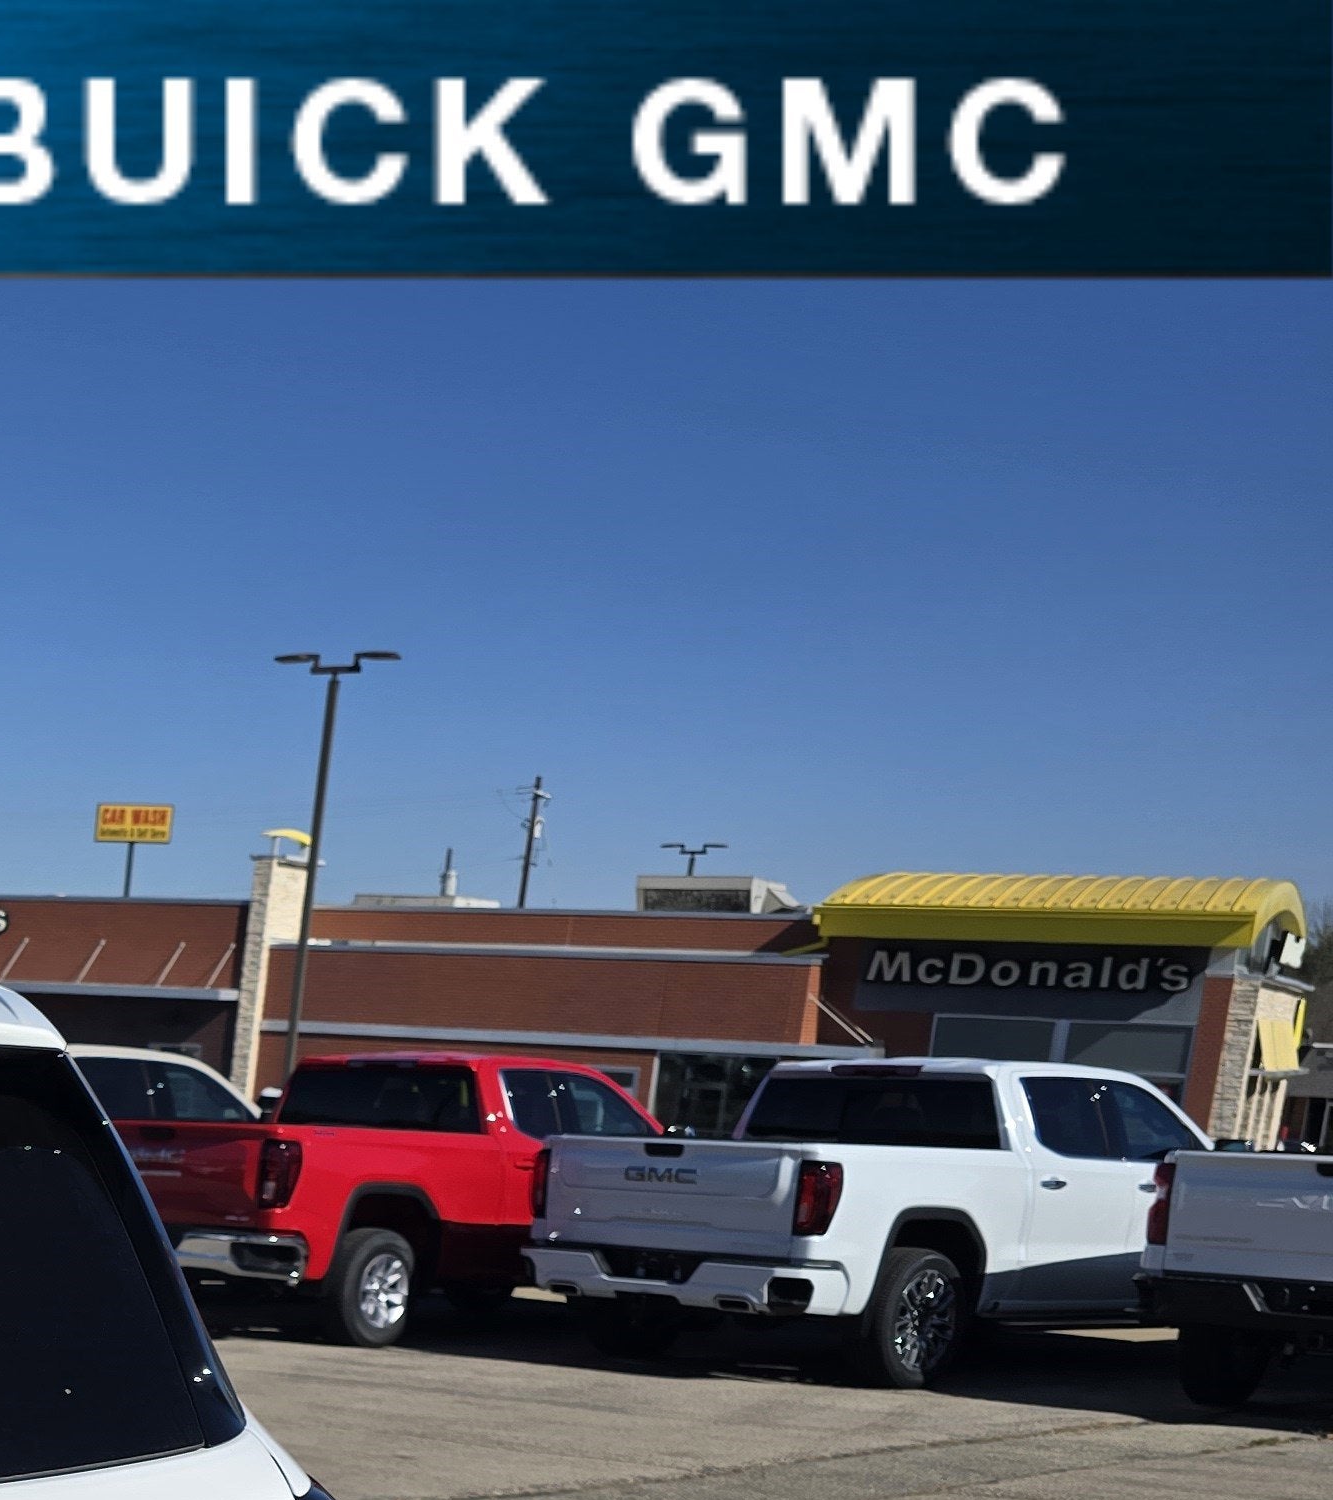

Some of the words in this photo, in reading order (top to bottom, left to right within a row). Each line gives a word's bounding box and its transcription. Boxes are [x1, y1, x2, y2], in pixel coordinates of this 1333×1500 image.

[101, 808, 126, 826] CAR
[131, 809, 170, 827] WASH
[865, 949, 1190, 992] McDonald's
[623, 1165, 698, 1186] GMC
